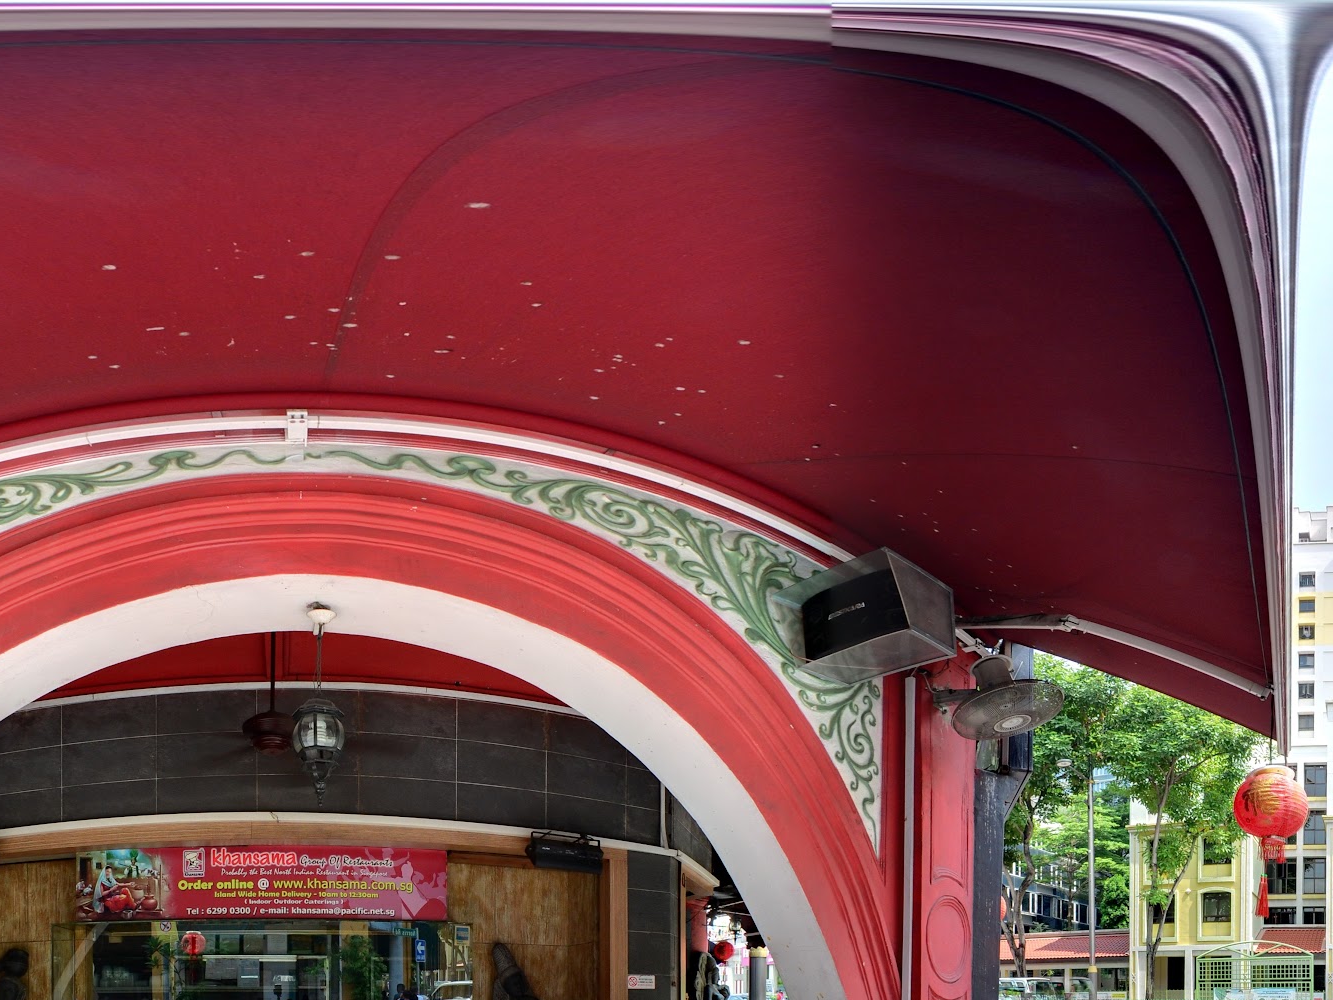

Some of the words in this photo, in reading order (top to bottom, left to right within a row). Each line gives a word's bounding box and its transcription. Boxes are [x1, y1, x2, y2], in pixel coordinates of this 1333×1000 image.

[211, 847, 297, 867] khansama
[300, 855, 328, 867] Group
[329, 855, 341, 869] Of
[342, 855, 394, 867] Restaurants
[221, 868, 248, 877] Probably
[316, 868, 350, 876] Restaurant
[359, 869, 389, 878] Singapore
[178, 879, 214, 890] Order
[216, 879, 254, 889] online
[258, 878, 270, 890] @
[273, 878, 413, 893] www.khansama.com.sg
[186, 907, 200, 915] Tel
[291, 906, 396, 917] khansama@pacific.net.sg
